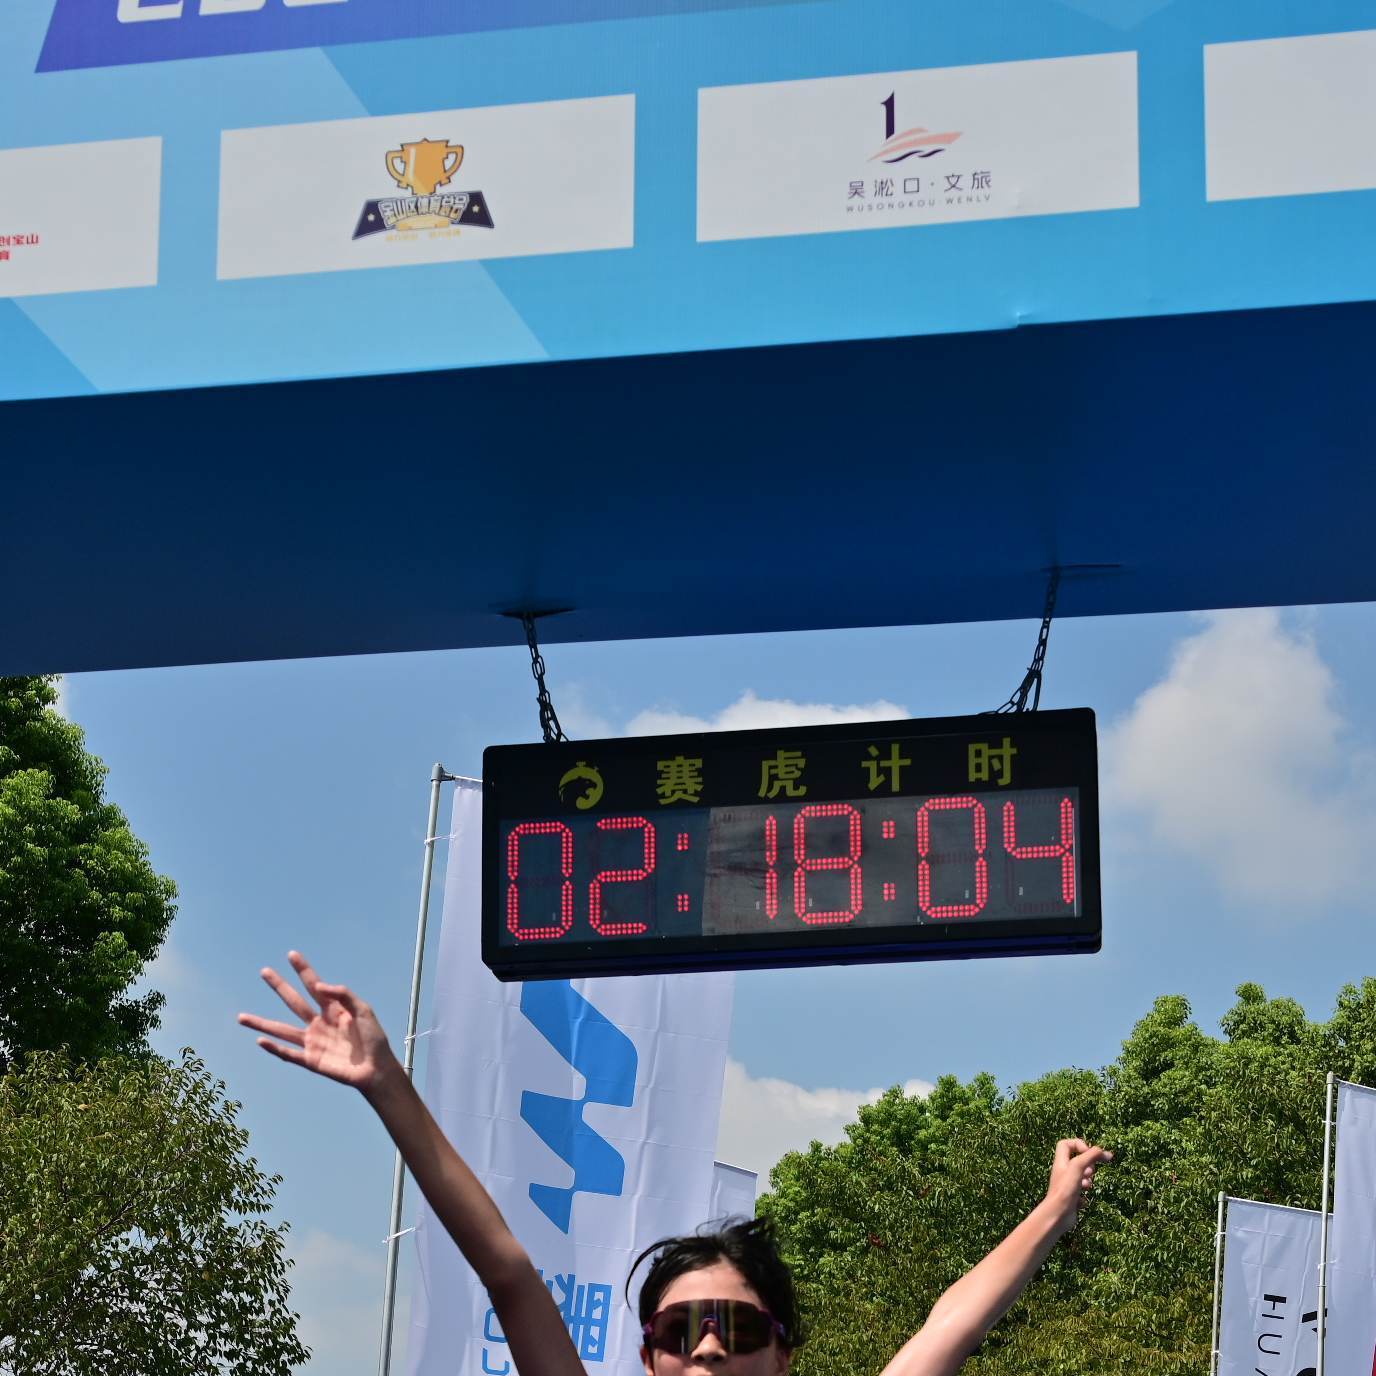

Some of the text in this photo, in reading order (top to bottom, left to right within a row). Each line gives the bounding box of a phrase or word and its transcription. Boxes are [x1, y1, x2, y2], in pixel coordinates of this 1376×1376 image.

[655, 736, 1018, 805] 赛虎计时
[505, 796, 1074, 942] 02:18:04
